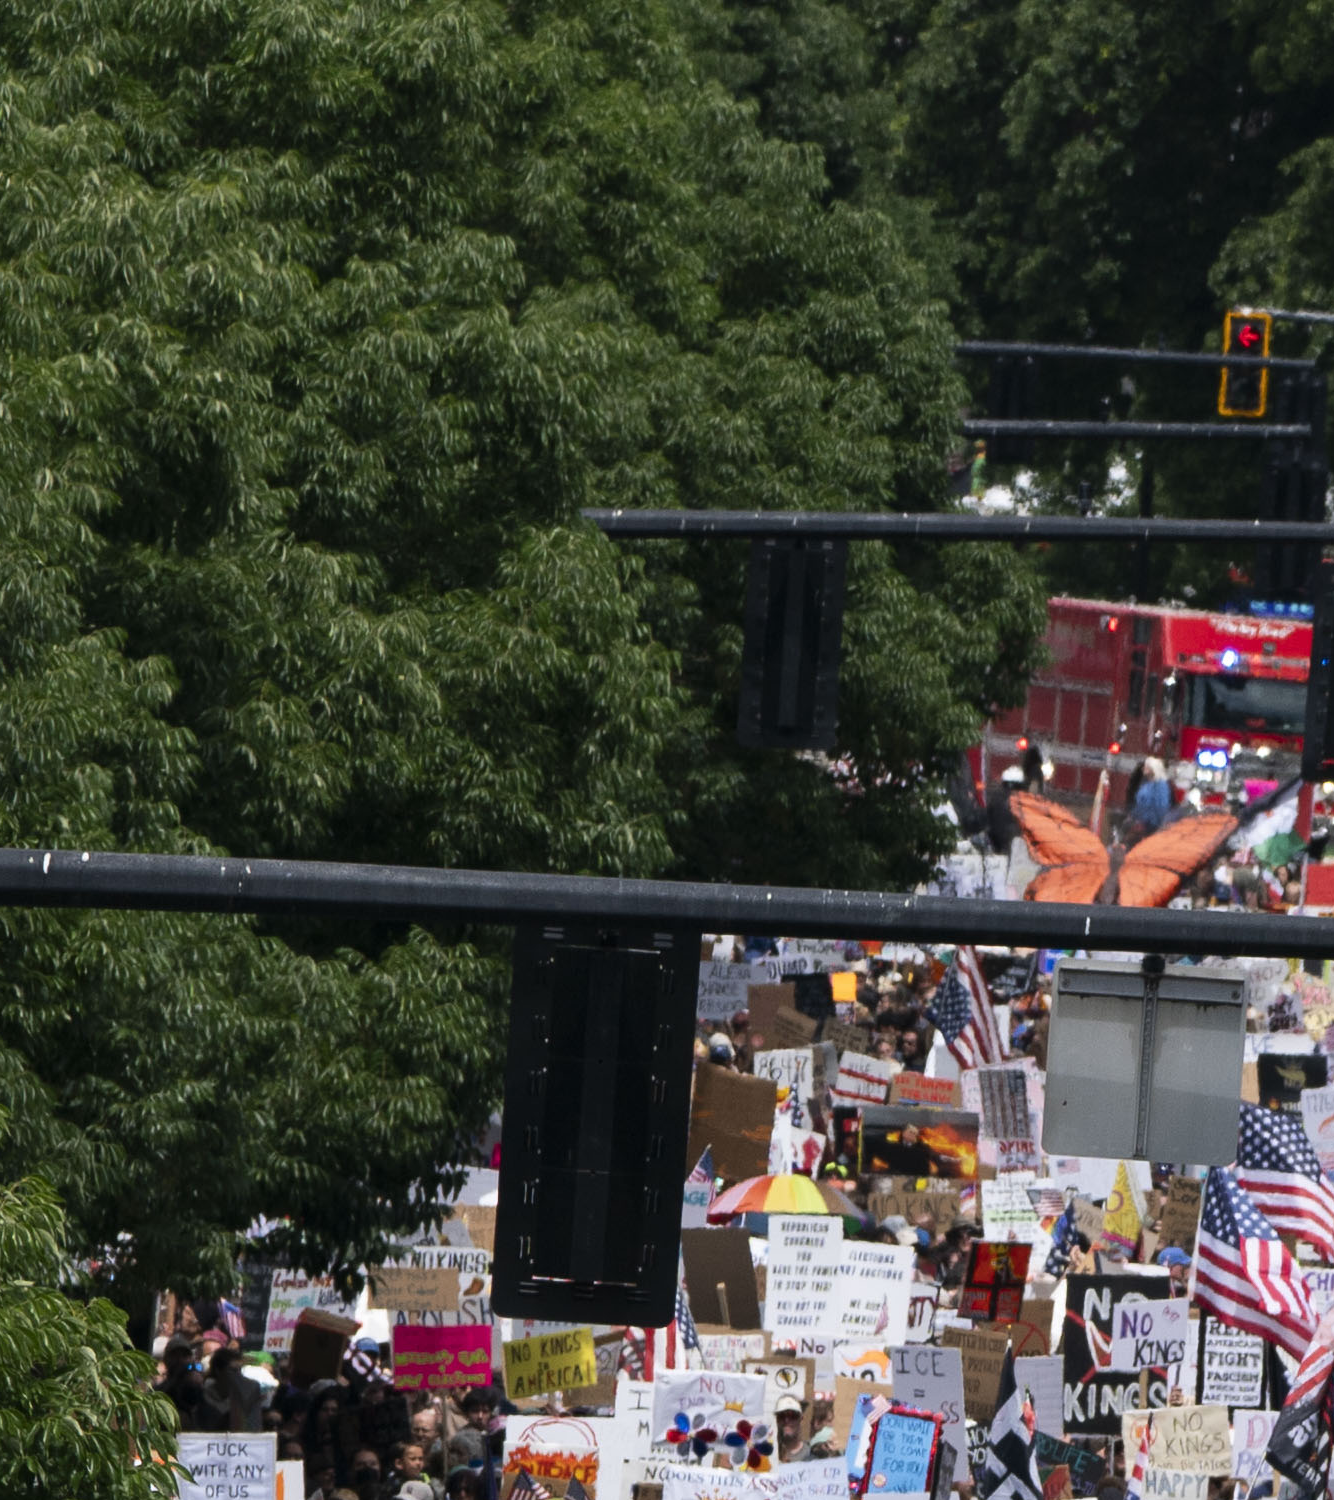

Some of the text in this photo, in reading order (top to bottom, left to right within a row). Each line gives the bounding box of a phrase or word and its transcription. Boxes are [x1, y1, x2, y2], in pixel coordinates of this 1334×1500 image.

[1120, 1314, 1152, 1338] NO
[511, 1335, 583, 1361] NO KINGS
[1134, 1339, 1185, 1367] KINGS
[894, 1349, 945, 1377] ICE
[206, 1442, 248, 1458] FUCK
[189, 1464, 265, 1480] WITH ANY
